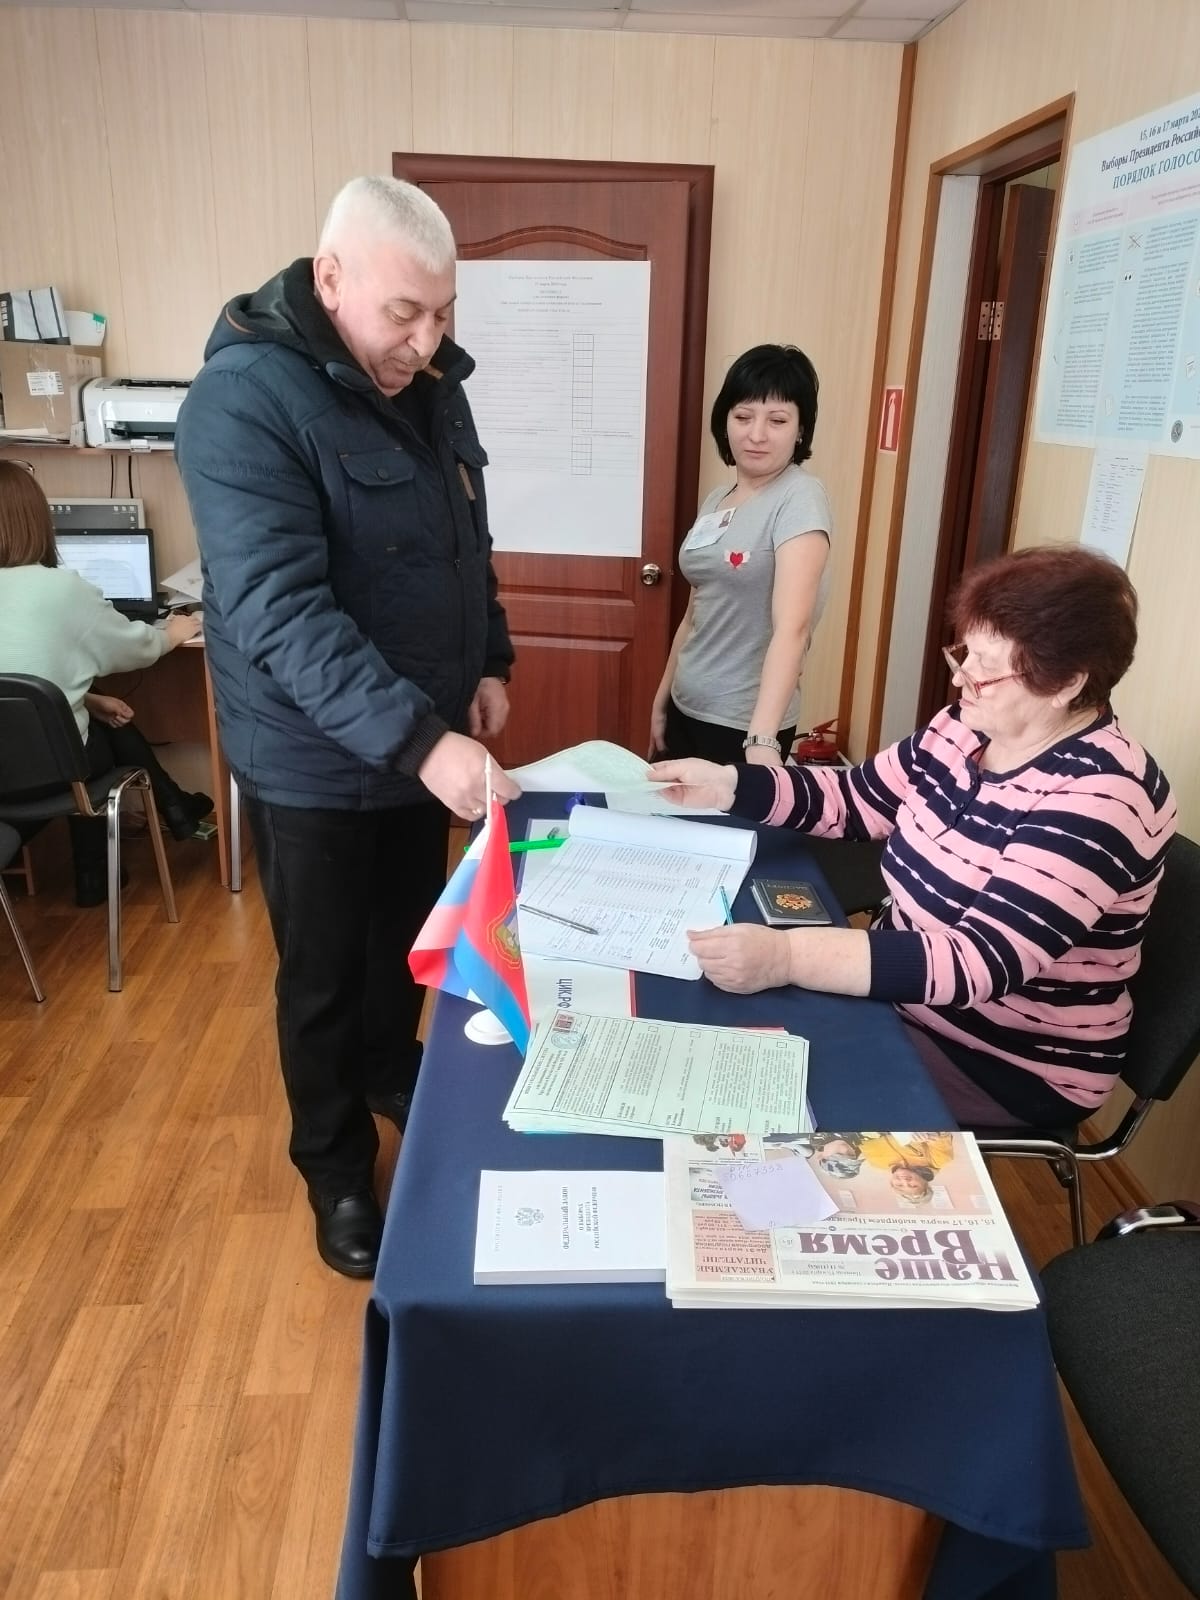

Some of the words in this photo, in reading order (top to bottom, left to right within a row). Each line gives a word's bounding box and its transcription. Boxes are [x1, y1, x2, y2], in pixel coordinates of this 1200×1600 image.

[1149, 125, 1157, 138] 16
[1162, 120, 1170, 132] 17
[1170, 115, 1189, 130] марта
[1101, 155, 1128, 172] Выборы
[1129, 140, 1170, 164] Президента
[1171, 126, 1200, 147] Россий
[1112, 163, 1157, 189] ПОРЯДОК
[556, 978, 573, 1009] ЦИК.РФ
[868, 1217, 917, 1226] выбираем
[797, 1229, 985, 1265] Время
[696, 1265, 774, 1274] УВАЖАЕМЫЕ
[702, 1256, 767, 1265] ЧИТАТЕЛИ!
[875, 1250, 1019, 1281] Наше
